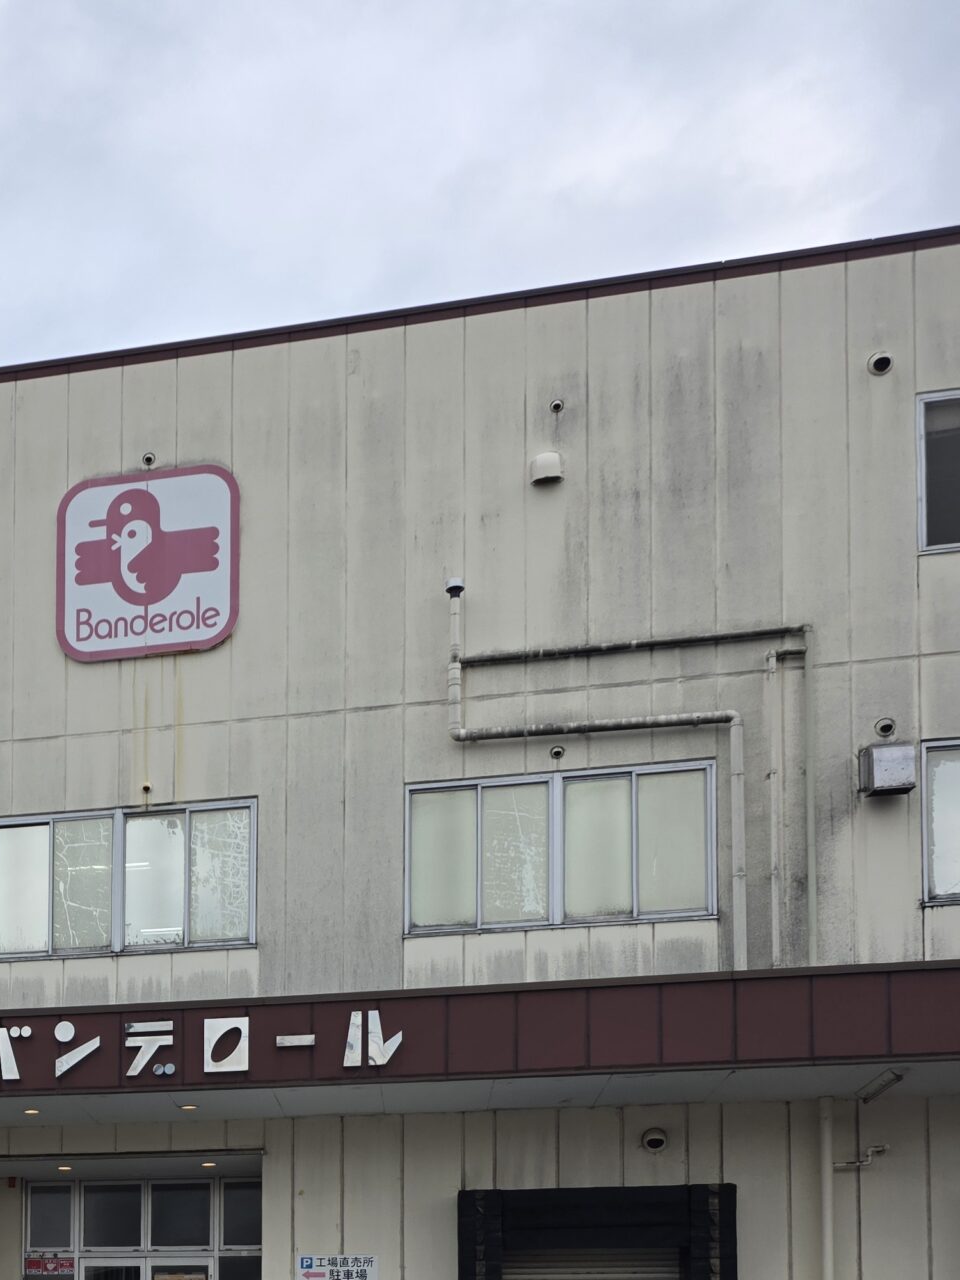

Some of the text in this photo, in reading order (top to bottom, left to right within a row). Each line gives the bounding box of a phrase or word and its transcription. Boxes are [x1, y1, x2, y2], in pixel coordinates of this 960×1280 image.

[76, 597, 220, 642] Banderole
[315, 1256, 374, 1268] 工場直売所
[329, 1269, 368, 1280] 駐車場
